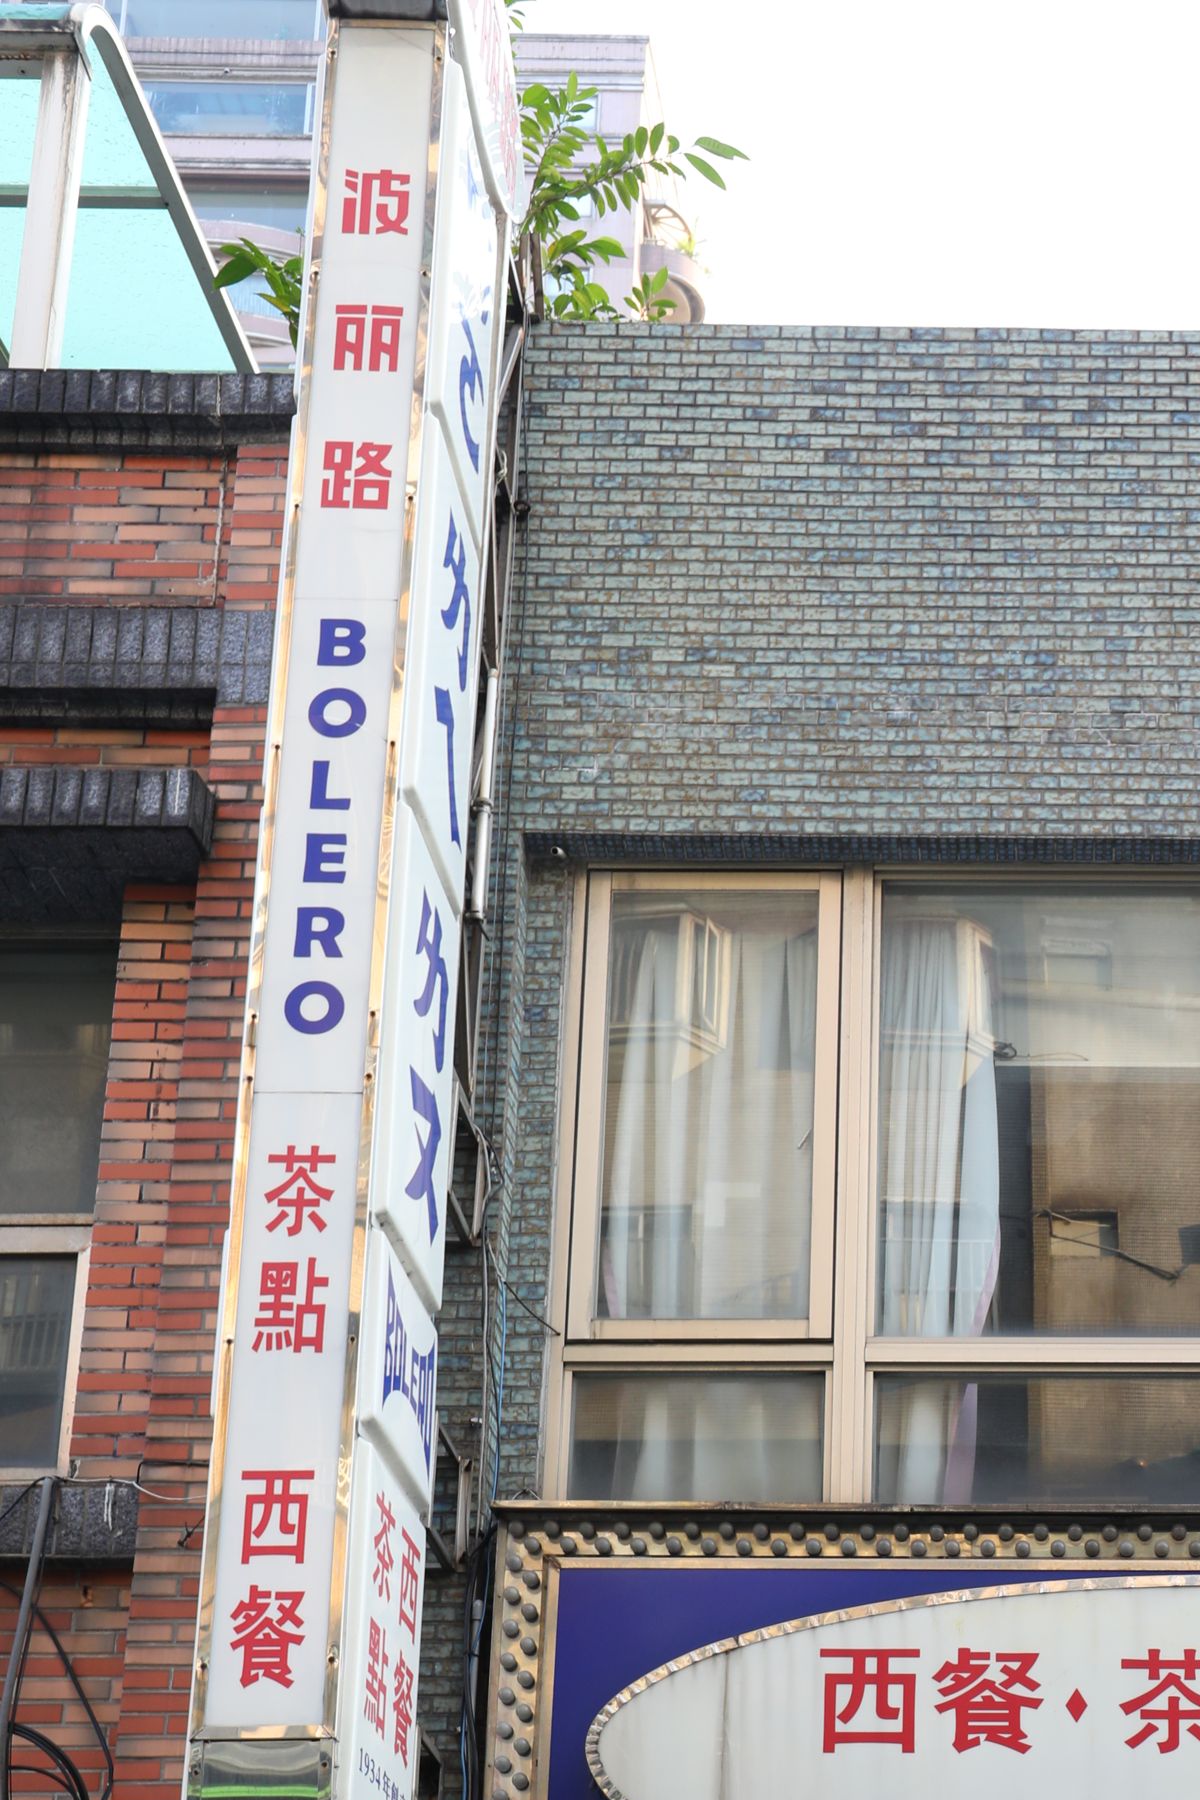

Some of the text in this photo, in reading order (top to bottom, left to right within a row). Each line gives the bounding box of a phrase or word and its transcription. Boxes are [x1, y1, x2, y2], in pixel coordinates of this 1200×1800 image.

[284, 618, 367, 1035] BOLERO
[252, 1144, 336, 1354] 茶點
[382, 1265, 437, 1481] BOLERO
[230, 1469, 314, 1689] 西餐
[819, 1647, 1044, 1754] 西餐
